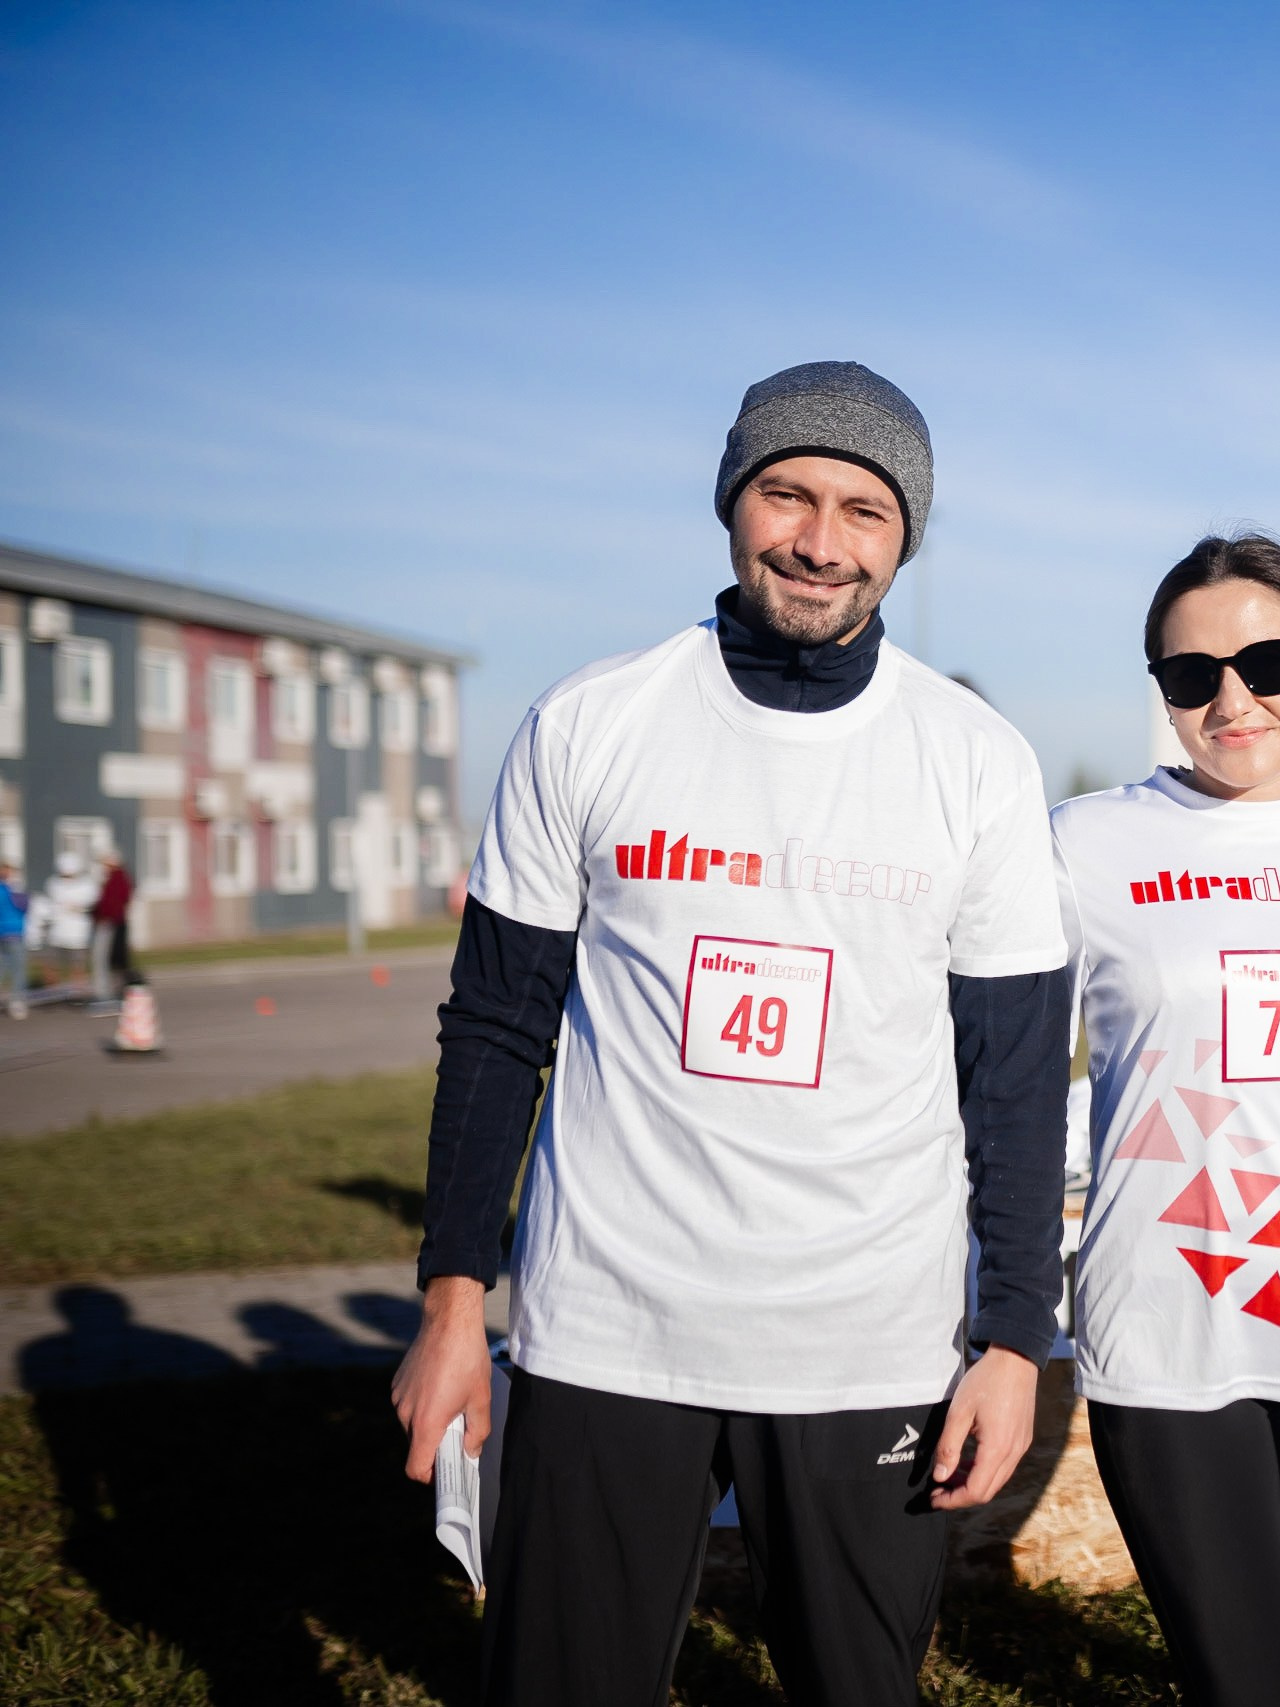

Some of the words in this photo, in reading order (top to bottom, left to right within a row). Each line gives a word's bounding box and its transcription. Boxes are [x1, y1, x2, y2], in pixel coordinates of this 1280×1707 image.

[615, 829, 932, 905] ultradecor
[701, 953, 821, 982] ultradecor
[720, 994, 788, 1057] 49
